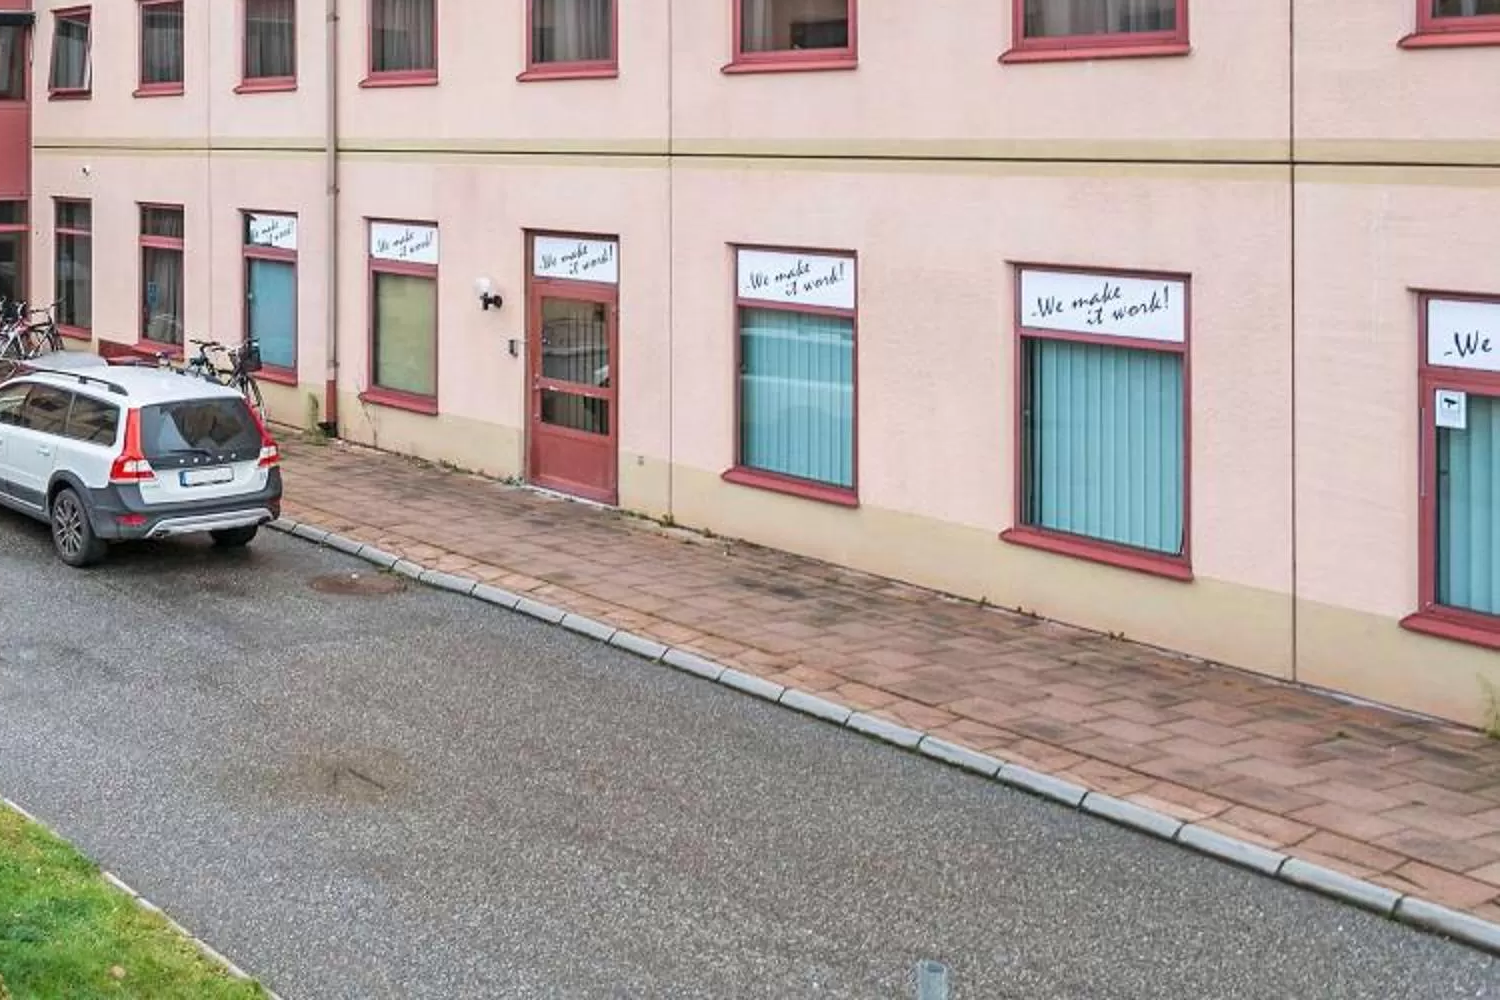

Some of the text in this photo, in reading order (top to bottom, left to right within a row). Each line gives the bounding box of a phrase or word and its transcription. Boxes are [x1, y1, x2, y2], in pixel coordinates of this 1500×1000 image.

[775, 259, 810, 282] make
[785, 260, 844, 297] it work!
[1031, 281, 1121, 318] We make
[1086, 284, 1169, 325] it work!
[1444, 329, 1493, 359] We
